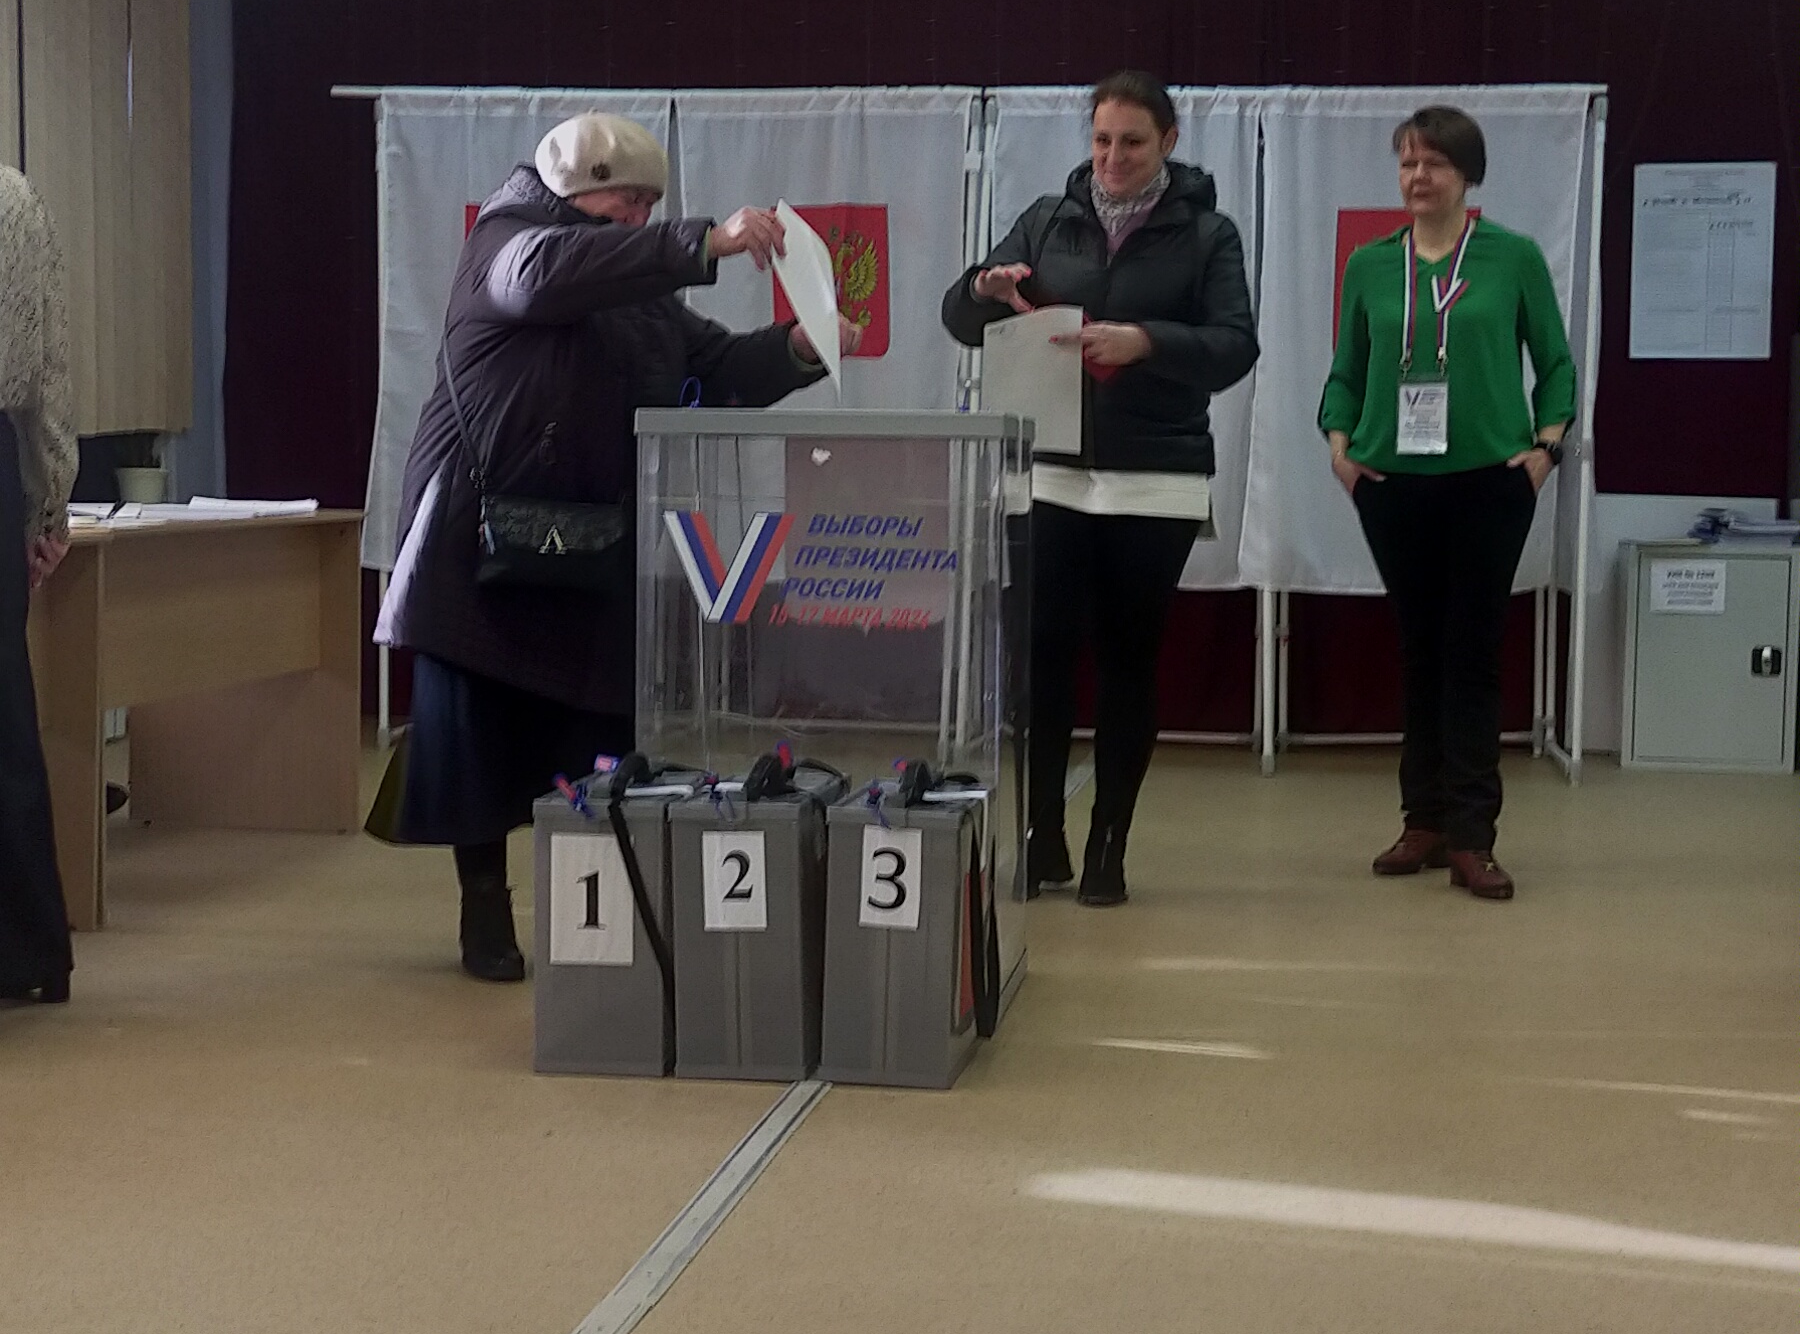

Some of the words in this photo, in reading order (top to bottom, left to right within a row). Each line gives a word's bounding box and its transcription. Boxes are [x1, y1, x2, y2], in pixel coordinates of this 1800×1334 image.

[808, 514, 924, 537] ВЫБОРЫ
[795, 545, 958, 573] ПРЕЗИДЕНТА
[780, 577, 885, 600] РОССИИ
[820, 605, 883, 628] МАРТА
[884, 607, 931, 630] 2024
[721, 849, 754, 903] 2
[867, 846, 907, 910] 3
[577, 869, 606, 930] 1
